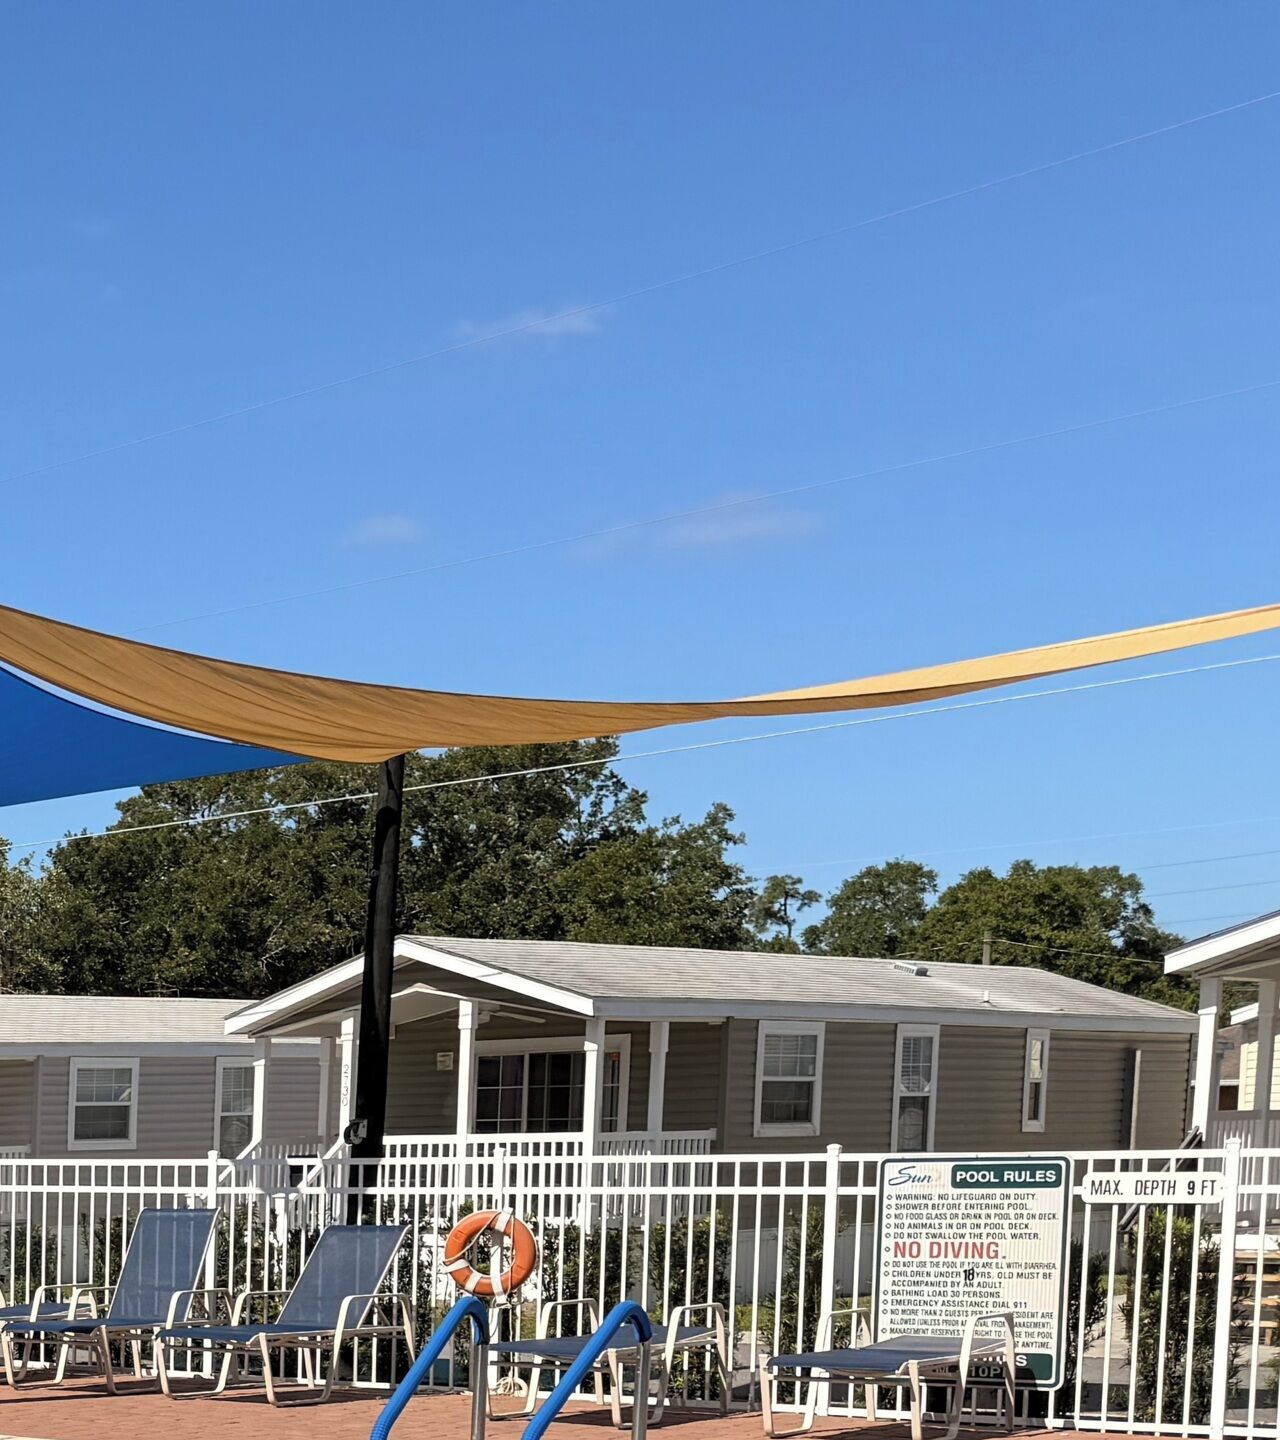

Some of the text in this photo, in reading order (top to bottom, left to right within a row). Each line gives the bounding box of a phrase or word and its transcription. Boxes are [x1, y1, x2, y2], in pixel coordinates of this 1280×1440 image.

[888, 1165, 932, 1186] Sun
[956, 1170, 1056, 1183] POOL RULES
[1090, 1179, 1217, 1196] MAX. DEPTH 9 FT
[938, 1193, 949, 1201] NO
[951, 1193, 997, 1201] LIFEGUARD
[999, 1193, 1011, 1201] ON
[894, 1203, 929, 1211] SHOWER
[931, 1203, 961, 1211] BEFORE
[964, 1203, 1005, 1211] ENTERING
[894, 1222, 905, 1230] NO
[907, 1222, 942, 1230] ANIMALS
[945, 1222, 953, 1230] IN
[956, 1222, 967, 1230] OR
[970, 1222, 981, 1230] ON
[984, 1222, 1005, 1230] POOL
[893, 1232, 904, 1240] DO
[907, 1232, 922, 1240] NOT
[925, 1232, 965, 1240] SWALLOW
[969, 1232, 984, 1240] THE
[986, 1232, 1007, 1240] POOL
[893, 1241, 921, 1259] NO
[942, 1261, 957, 1269] POOL
[891, 1270, 931, 1278] CHILDREN
[962, 1267, 975, 1282] 18
[997, 1271, 1014, 1280] OLD
[1016, 1272, 1040, 1280] MUST
[1042, 1272, 1053, 1280] BE
[891, 1280, 948, 1288] ACCOMPANIED
[891, 1289, 925, 1297] BATHING
[927, 1290, 948, 1298] LOAD
[950, 1290, 960, 1298] 30
[890, 1299, 1027, 1309] EMERGENCY ASSISTANCE DIAL 911
[890, 1308, 900, 1316] NO
[901, 1308, 919, 1316] MORE
[944, 1309, 969, 1317] GUESTS
[1013, 1311, 1039, 1319] ESIDENT
[1024, 1331, 1035, 1339] THE
